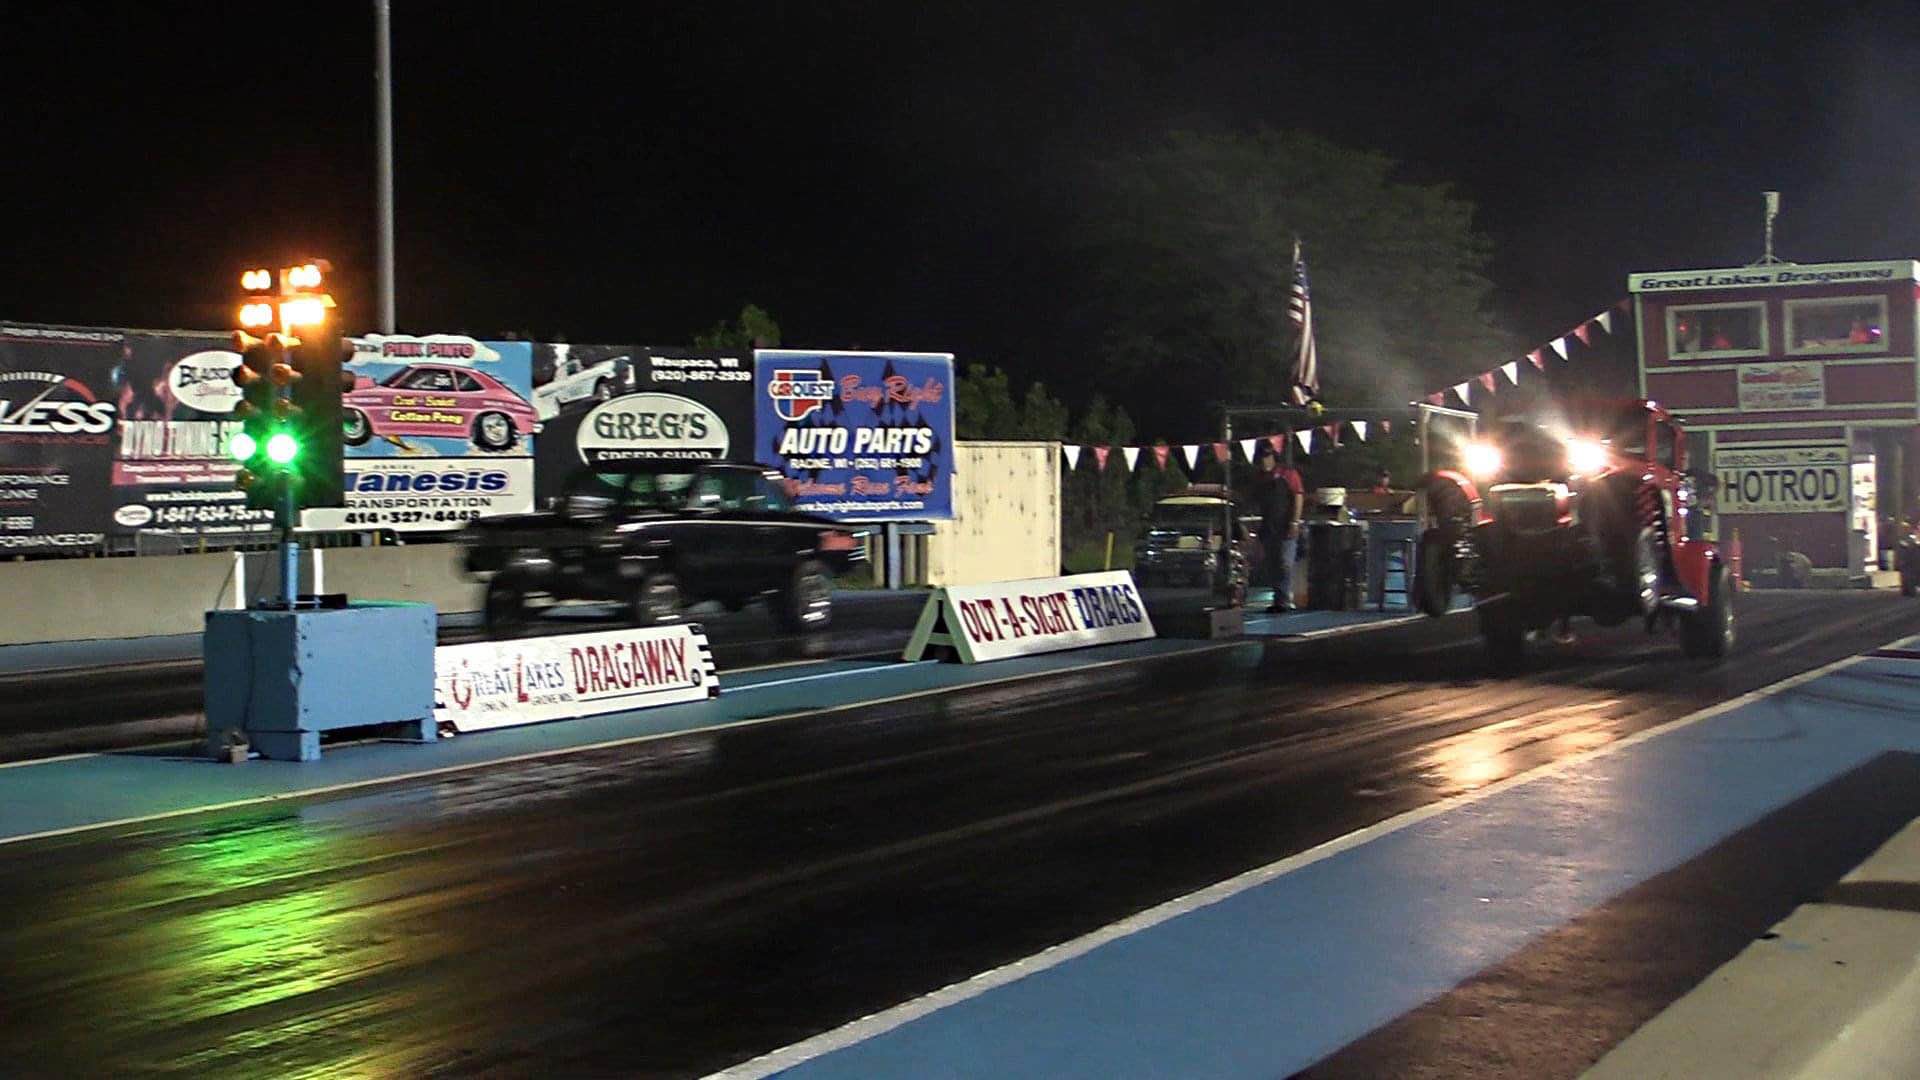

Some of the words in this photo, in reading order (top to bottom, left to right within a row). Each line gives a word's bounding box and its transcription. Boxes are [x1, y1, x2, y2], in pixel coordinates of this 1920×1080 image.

[1641, 275, 1707, 289] Great
[1708, 272, 1771, 287] Lakes
[1776, 267, 1893, 285] Dragaway
[382, 342, 423, 358] PINK
[427, 342, 475, 358] PINTO
[770, 382, 834, 398] CARQUEST
[594, 411, 708, 440] GREG'S
[778, 427, 848, 455] AUTO
[853, 427, 933, 455] PARTS
[1723, 469, 1839, 503] HOTROD
[960, 592, 1078, 643] OUT-A-SIGHT
[1071, 584, 1143, 630] DRAGS
[516, 653, 566, 703] LAKES
[571, 637, 690, 695] DRAGAWAY
